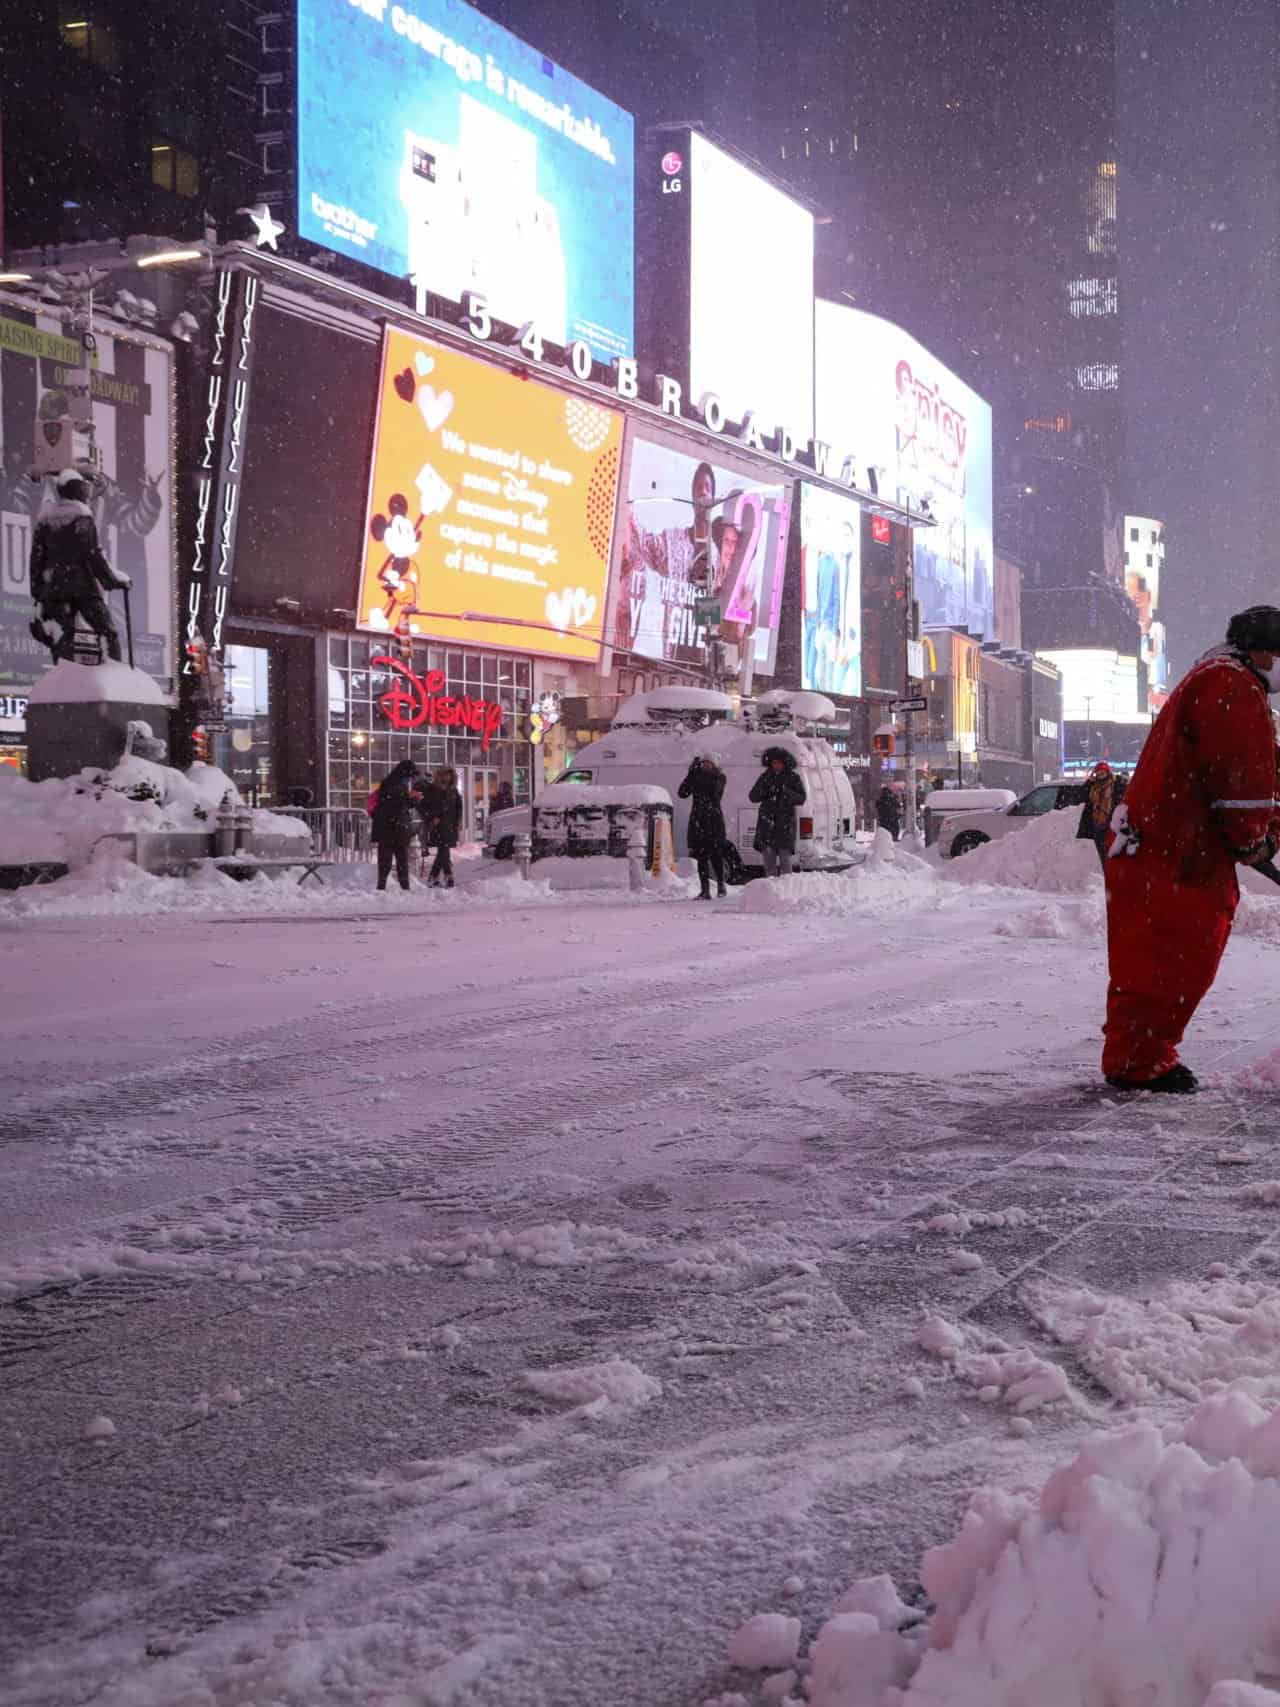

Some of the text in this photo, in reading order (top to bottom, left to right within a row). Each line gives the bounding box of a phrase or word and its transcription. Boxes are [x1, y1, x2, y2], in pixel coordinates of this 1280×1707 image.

[392, 6, 483, 82] courage
[486, 54, 505, 96] is
[662, 179, 682, 194] LG
[410, 273, 887, 497] 1540 BROADWAY
[442, 428, 465, 455] We
[468, 441, 520, 471] wanted
[371, 656, 504, 752] Disney
